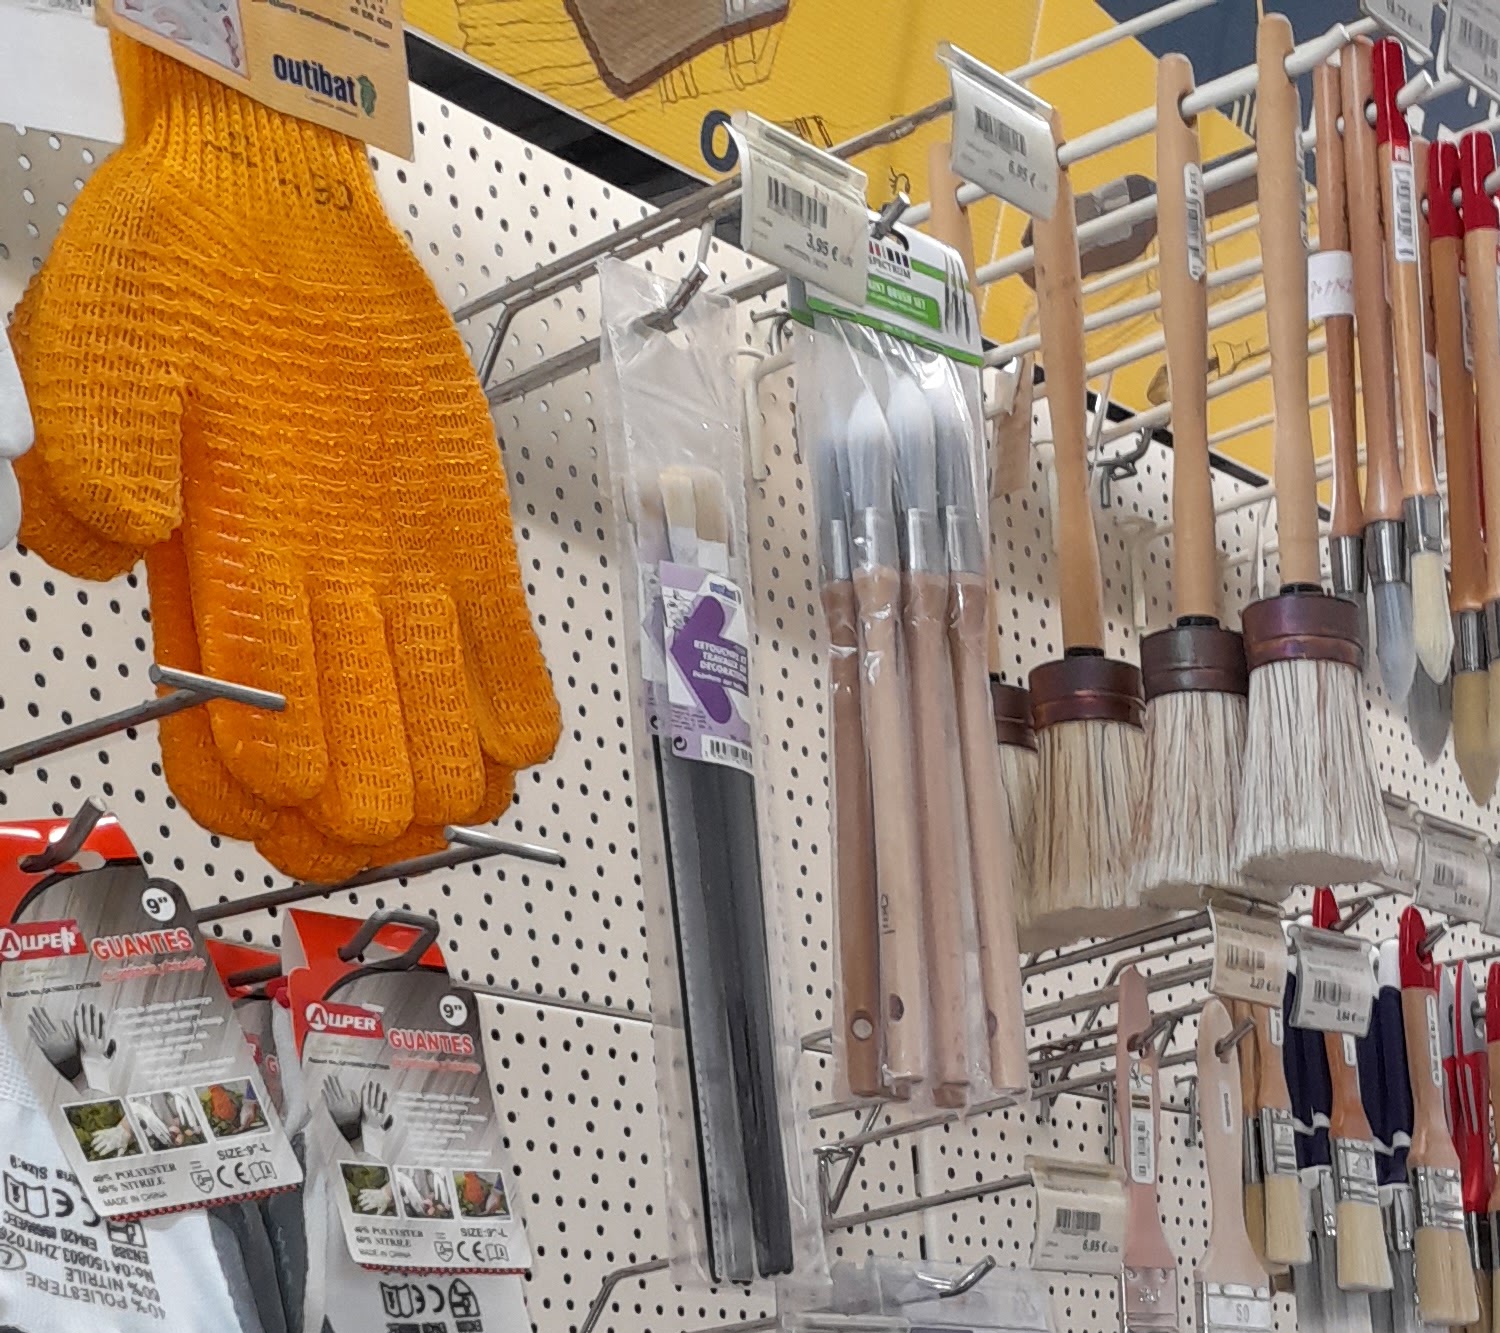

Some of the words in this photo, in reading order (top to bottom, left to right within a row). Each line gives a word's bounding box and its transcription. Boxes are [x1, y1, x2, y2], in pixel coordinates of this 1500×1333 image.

[91, 927, 195, 960] GUANTES
[388, 1027, 474, 1056] GUANTES
[65, 1266, 125, 1293] NITRILE
